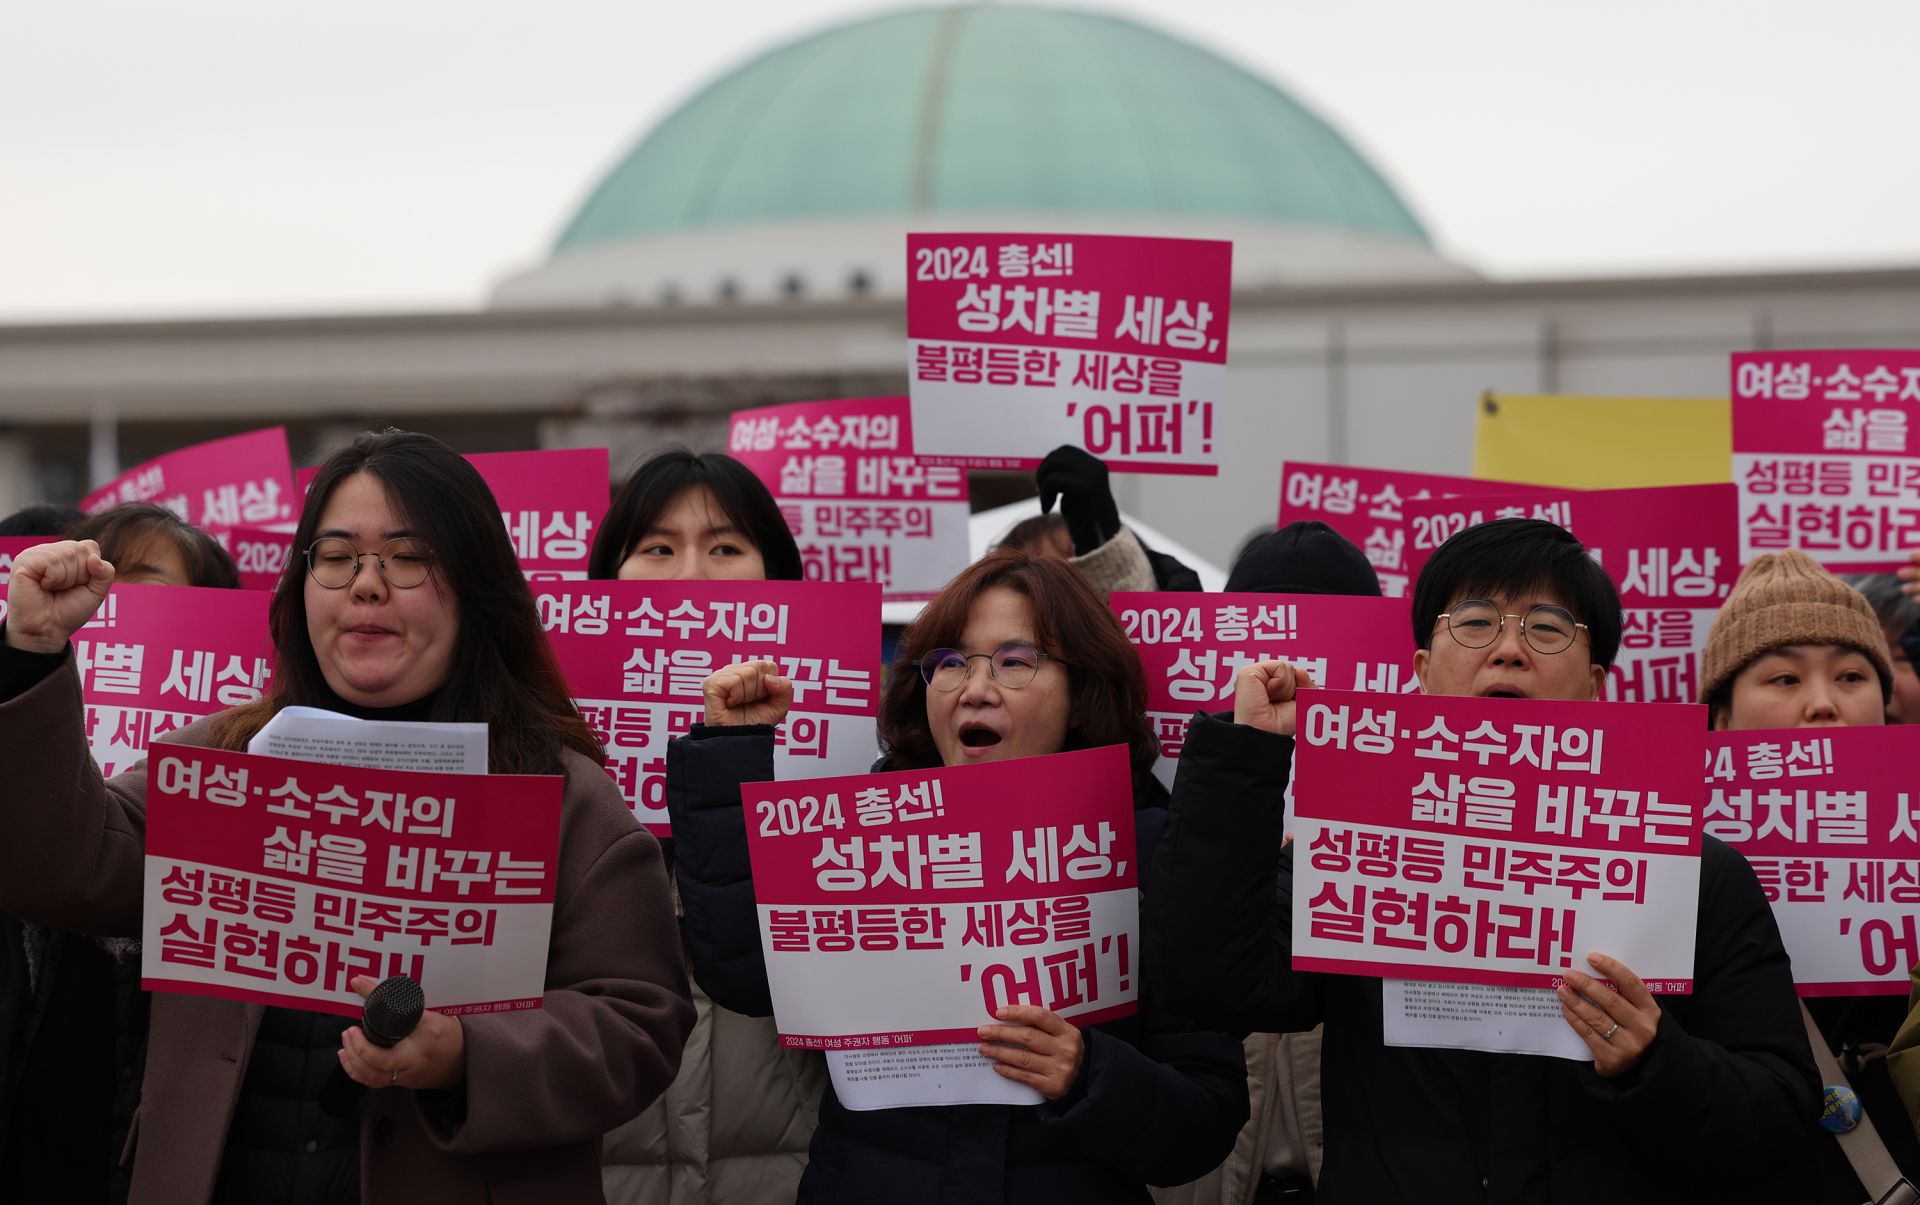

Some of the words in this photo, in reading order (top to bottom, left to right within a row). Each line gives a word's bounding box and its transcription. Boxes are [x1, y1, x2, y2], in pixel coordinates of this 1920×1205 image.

[916, 247, 989, 281] 2024
[998, 243, 1073, 278] 총선!
[956, 283, 1100, 339] 성차별
[1115, 294, 1220, 353] 세상,
[916, 344, 1060, 387] 불평등한
[1072, 354, 1182, 397] 세상을
[1737, 361, 1920, 402] 여성·소수자
[730, 415, 899, 453] 여성·소수자의
[1066, 400, 1213, 455] '어퍼'!
[1823, 408, 1908, 452] 삶을
[779, 455, 846, 495] 삶을
[1747, 460, 1852, 496] 성평등
[815, 507, 932, 538] 민주주의
[1620, 547, 1730, 598] 세상,
[536, 593, 789, 645] 여성·소수자의
[1121, 607, 1204, 645] 2024
[1214, 604, 1297, 642] 총선!
[1622, 610, 1694, 648] 상을
[622, 648, 714, 696] 삶을
[1305, 704, 1604, 775] 여성·소수자의
[1747, 738, 1834, 780] 총선!
[157, 756, 456, 838] 여성·소수자의
[756, 793, 845, 837] 2024
[855, 778, 945, 827] 총선!
[1410, 772, 1517, 831] 삶을
[1535, 784, 1693, 846] 바꾸는
[1703, 788, 1868, 844] 성차별
[263, 825, 367, 885] 삶을
[385, 845, 546, 896] 바꾸는
[812, 831, 985, 892] 성차별
[1006, 821, 1129, 884] 세상,
[1309, 827, 1446, 884] 성평등
[1463, 844, 1648, 904] 민주주의
[1751, 860, 1829, 902] 등한
[161, 866, 296, 925] 성평등
[313, 891, 498, 947] 민주주의
[769, 907, 947, 952] 불평등한
[961, 895, 1092, 948] 세상을
[1309, 882, 1577, 968] 실현하라!
[960, 933, 1130, 1021] '어퍼'!
[1665, 982, 1687, 992] '어퍼'
[785, 1036, 804, 1047] 2024
[824, 1038, 842, 1048] 여성
[843, 1036, 870, 1048] 주권자
[872, 1034, 890, 1046] 행동
[891, 1033, 914, 1044] '어퍼'
